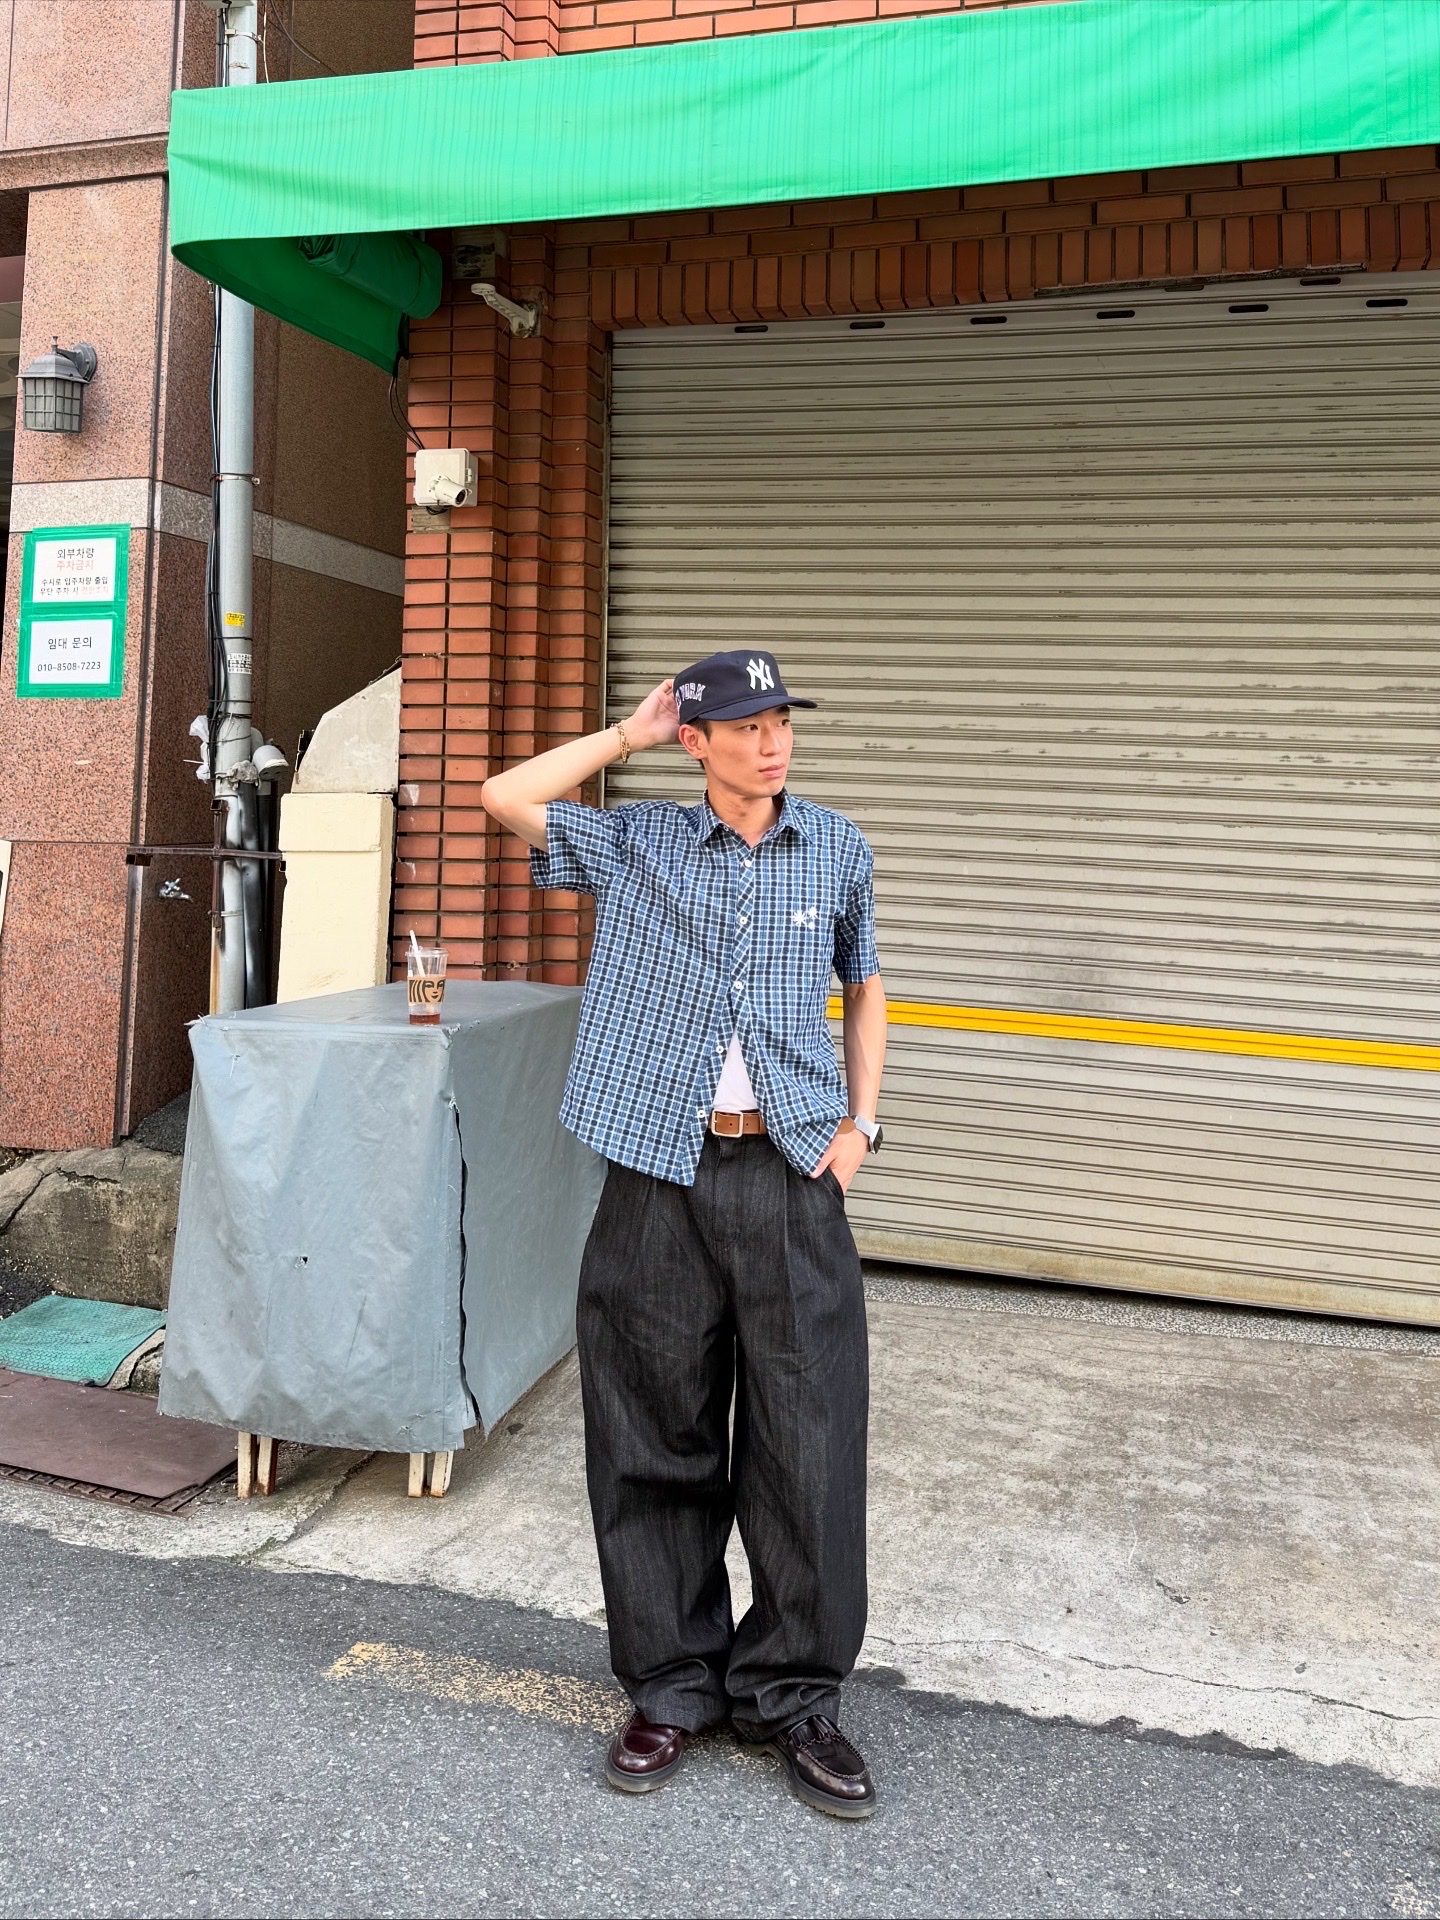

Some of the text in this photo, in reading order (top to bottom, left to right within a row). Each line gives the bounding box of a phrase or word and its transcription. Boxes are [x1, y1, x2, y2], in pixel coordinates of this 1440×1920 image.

[57, 548, 94, 559] 외부차량
[57, 559, 94, 571] 주차금지
[42, 576, 108, 586] 수시로 입주차량 출입
[40, 587, 53, 596] 무단
[56, 587, 69, 596] 주차
[73, 586, 79, 595] 시
[48, 636, 92, 650] 임대 문의
[37, 661, 101, 672] 010-8508-7223
[746, 658, 775, 691] NY
